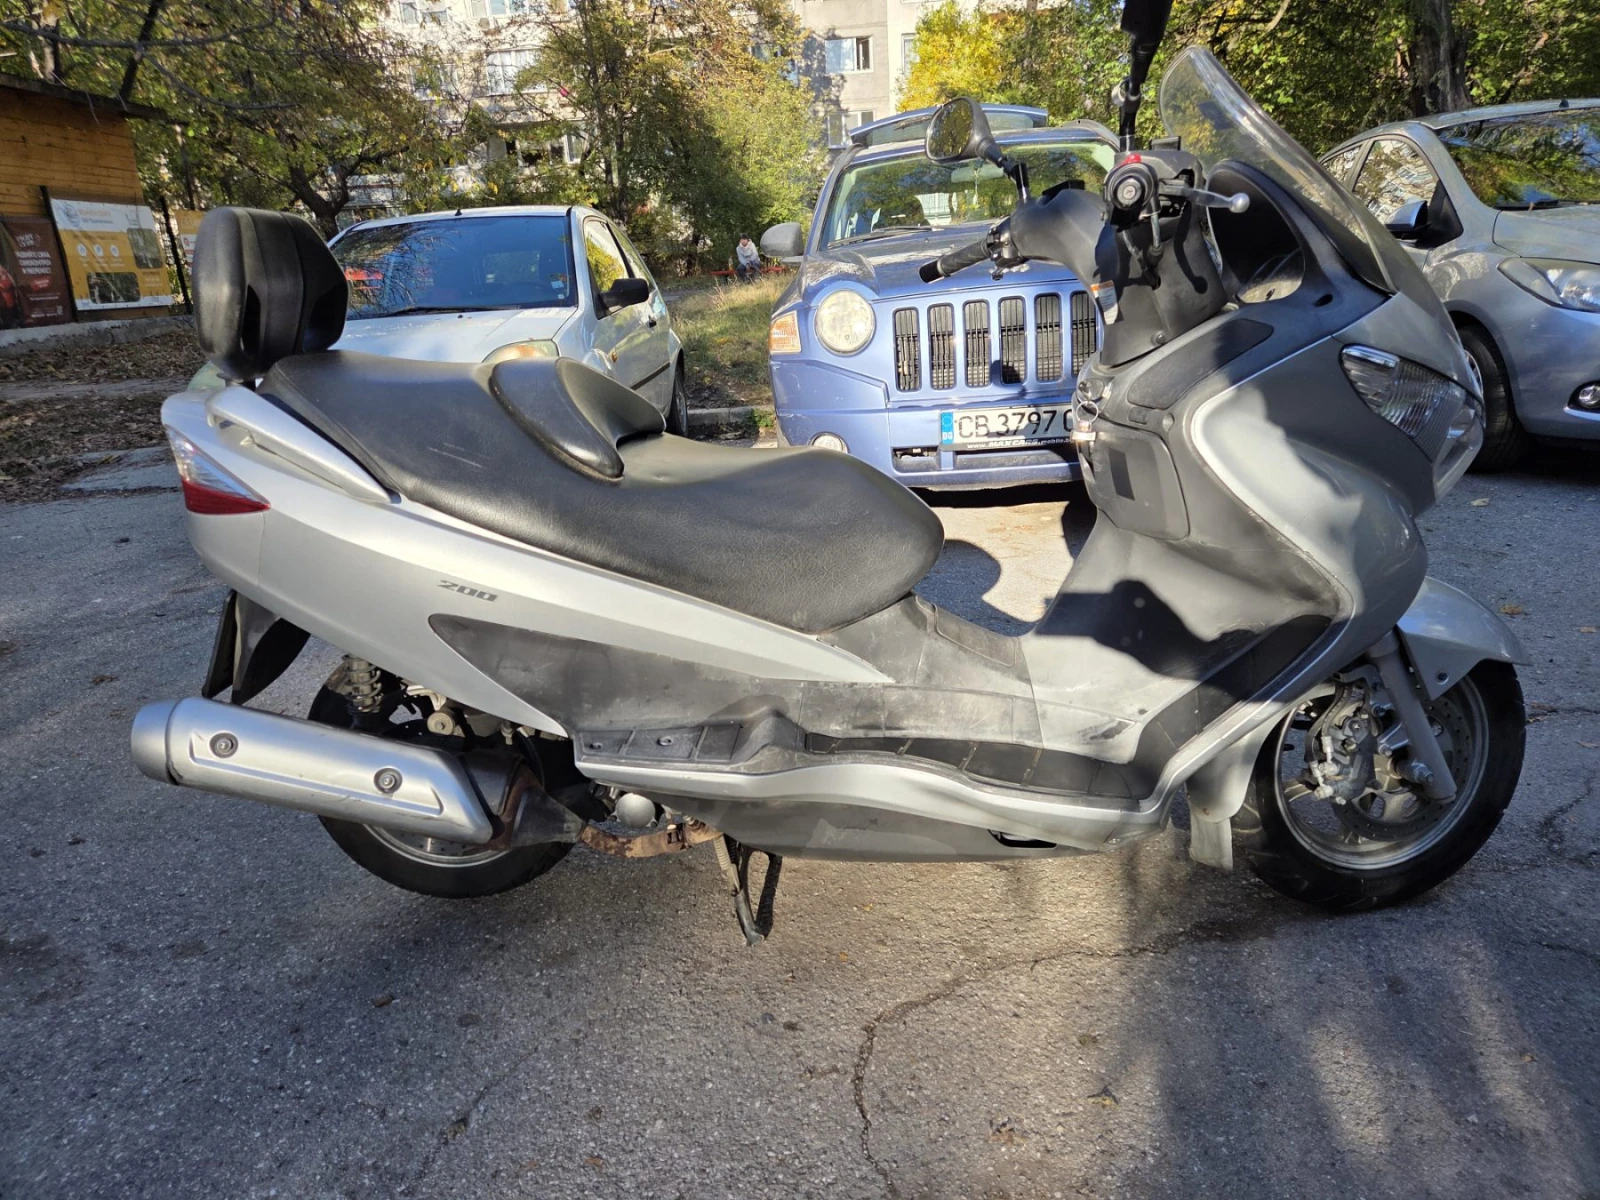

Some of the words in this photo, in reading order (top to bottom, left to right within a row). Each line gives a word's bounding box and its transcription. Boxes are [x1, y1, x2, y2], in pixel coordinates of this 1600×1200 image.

[958, 415, 989, 438] CB
[998, 410, 1057, 436] 3797
[437, 580, 498, 602] 200
